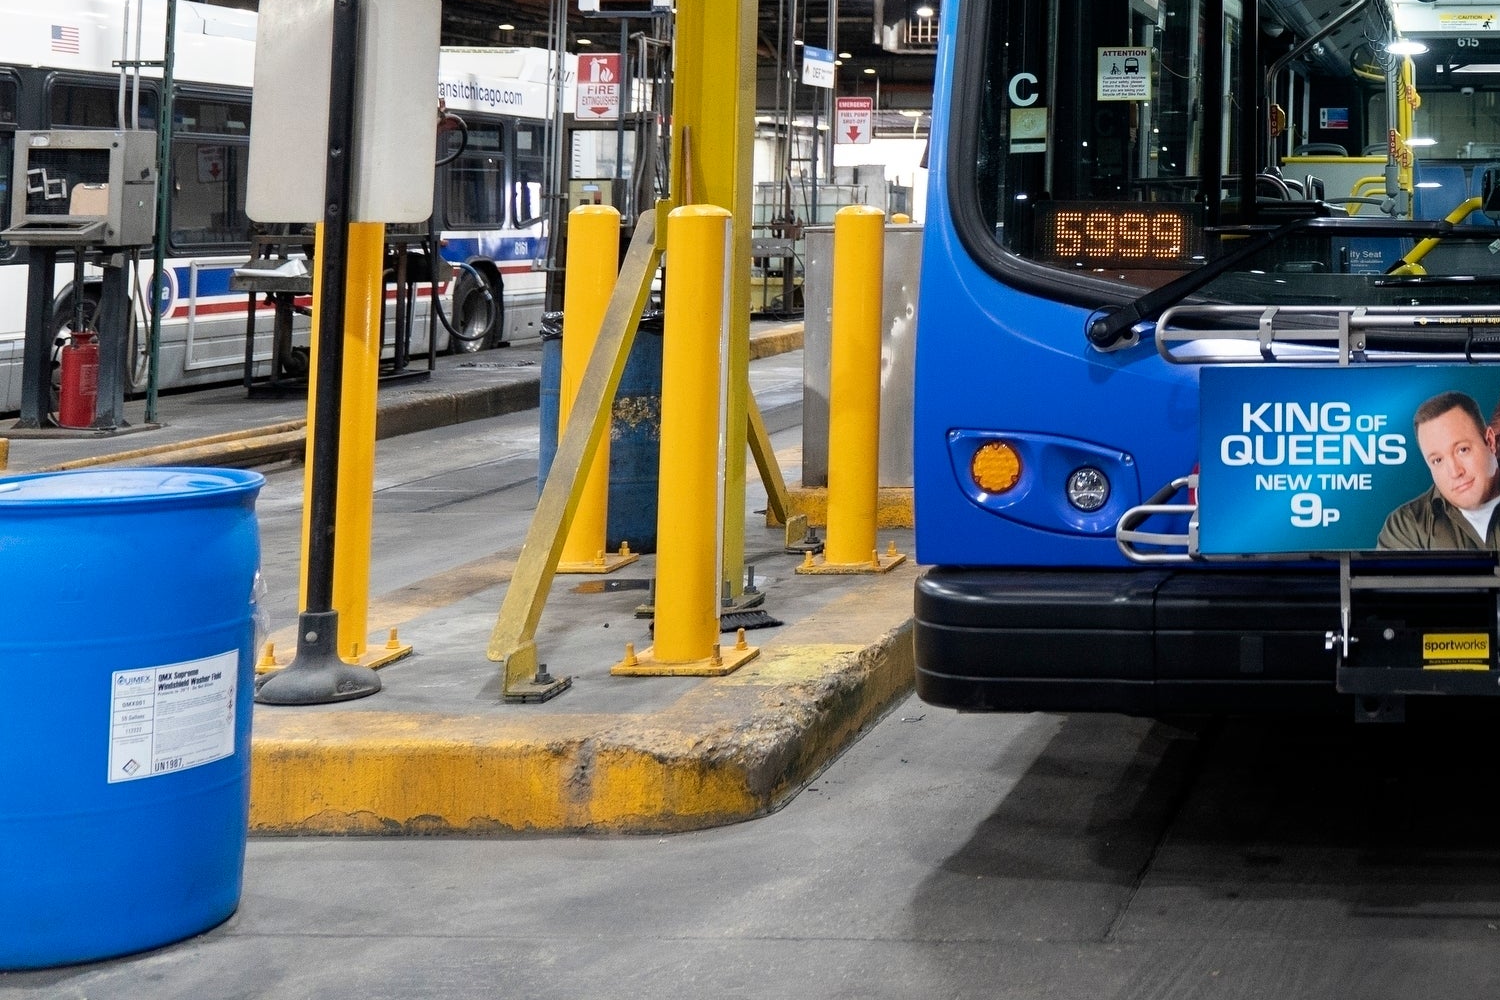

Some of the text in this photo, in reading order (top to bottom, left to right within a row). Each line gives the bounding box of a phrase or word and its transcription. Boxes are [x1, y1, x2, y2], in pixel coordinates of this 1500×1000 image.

[587, 85, 615, 95] FIRE
[1008, 72, 1039, 107] C
[581, 96, 619, 106] EXTINGUISHER
[838, 101, 871, 109] EMERGENCY
[1056, 212, 1181, 258] 5999
[1362, 250, 1382, 258] Seat
[1241, 401, 1388, 434] KING OF
[1220, 434, 1408, 467] QUEENS
[1255, 473, 1373, 491] NEW TIME
[1424, 638, 1487, 653] sportworks
[174, 669, 200, 680] Supreme
[157, 680, 190, 692] Windshield
[190, 675, 210, 686] Washer
